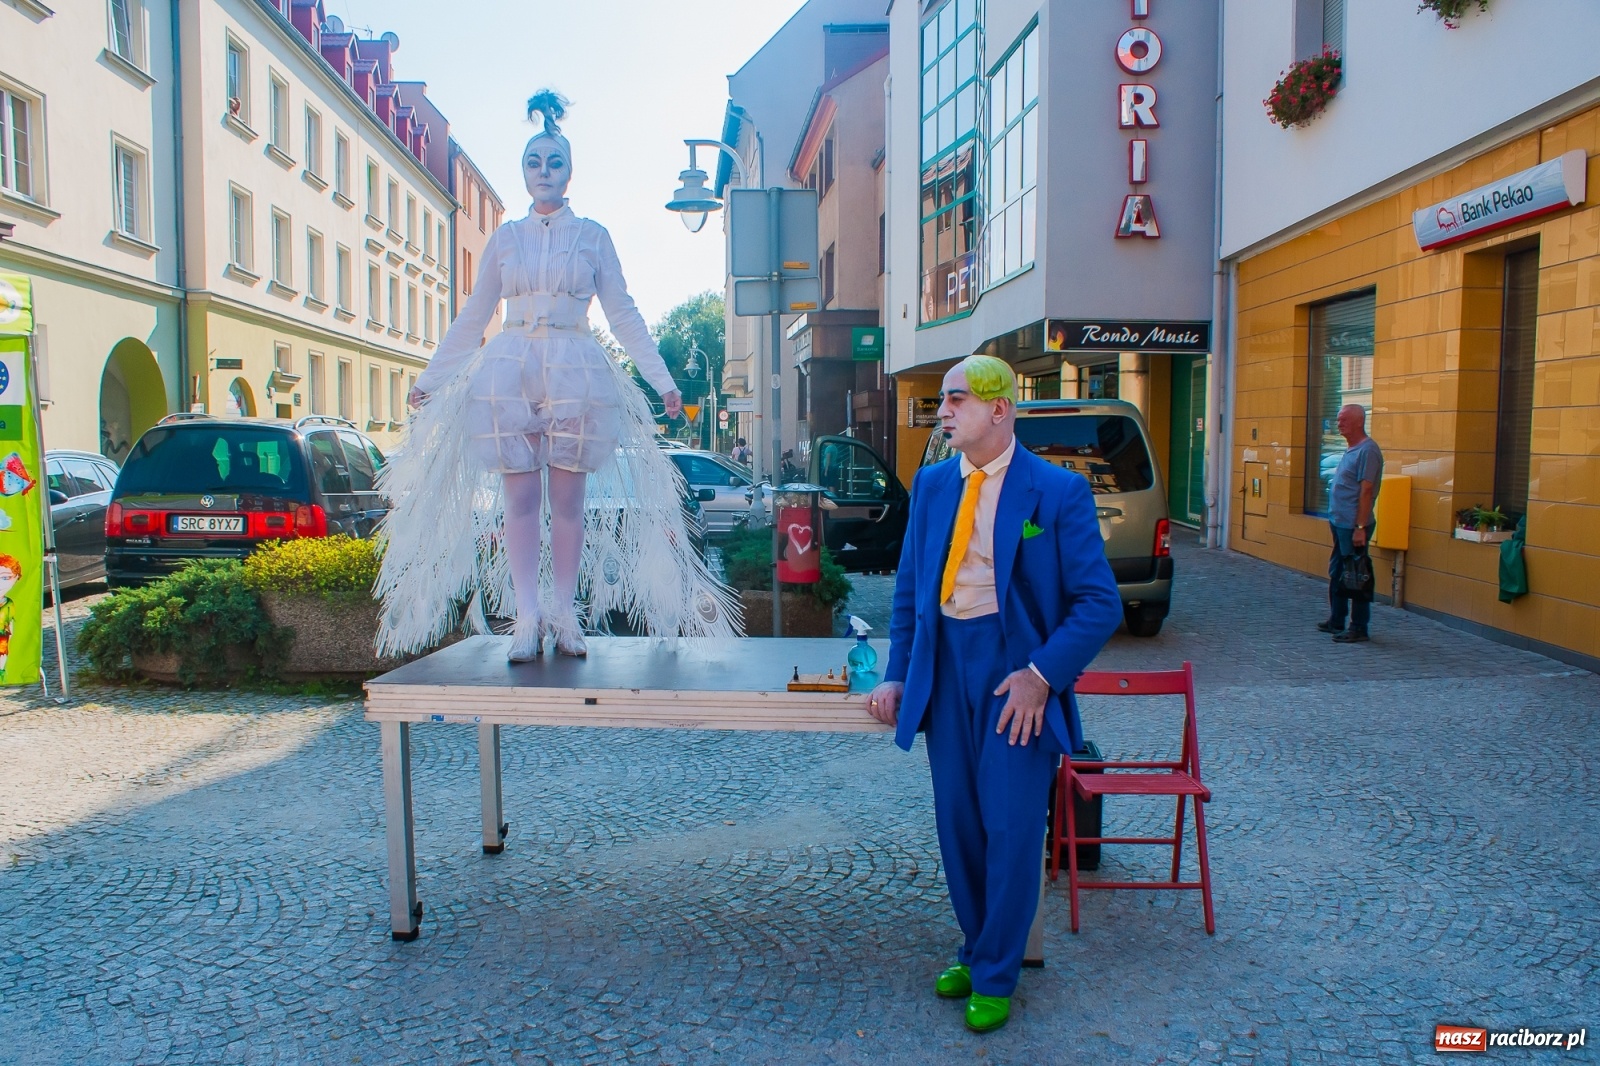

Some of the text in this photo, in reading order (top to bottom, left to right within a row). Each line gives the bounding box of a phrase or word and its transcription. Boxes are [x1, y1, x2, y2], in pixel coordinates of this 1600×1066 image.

[1461, 185, 1533, 223] Bank Pekao
[1081, 325, 1199, 346] Rondo Music
[180, 517, 240, 531] SRC 8YX7
